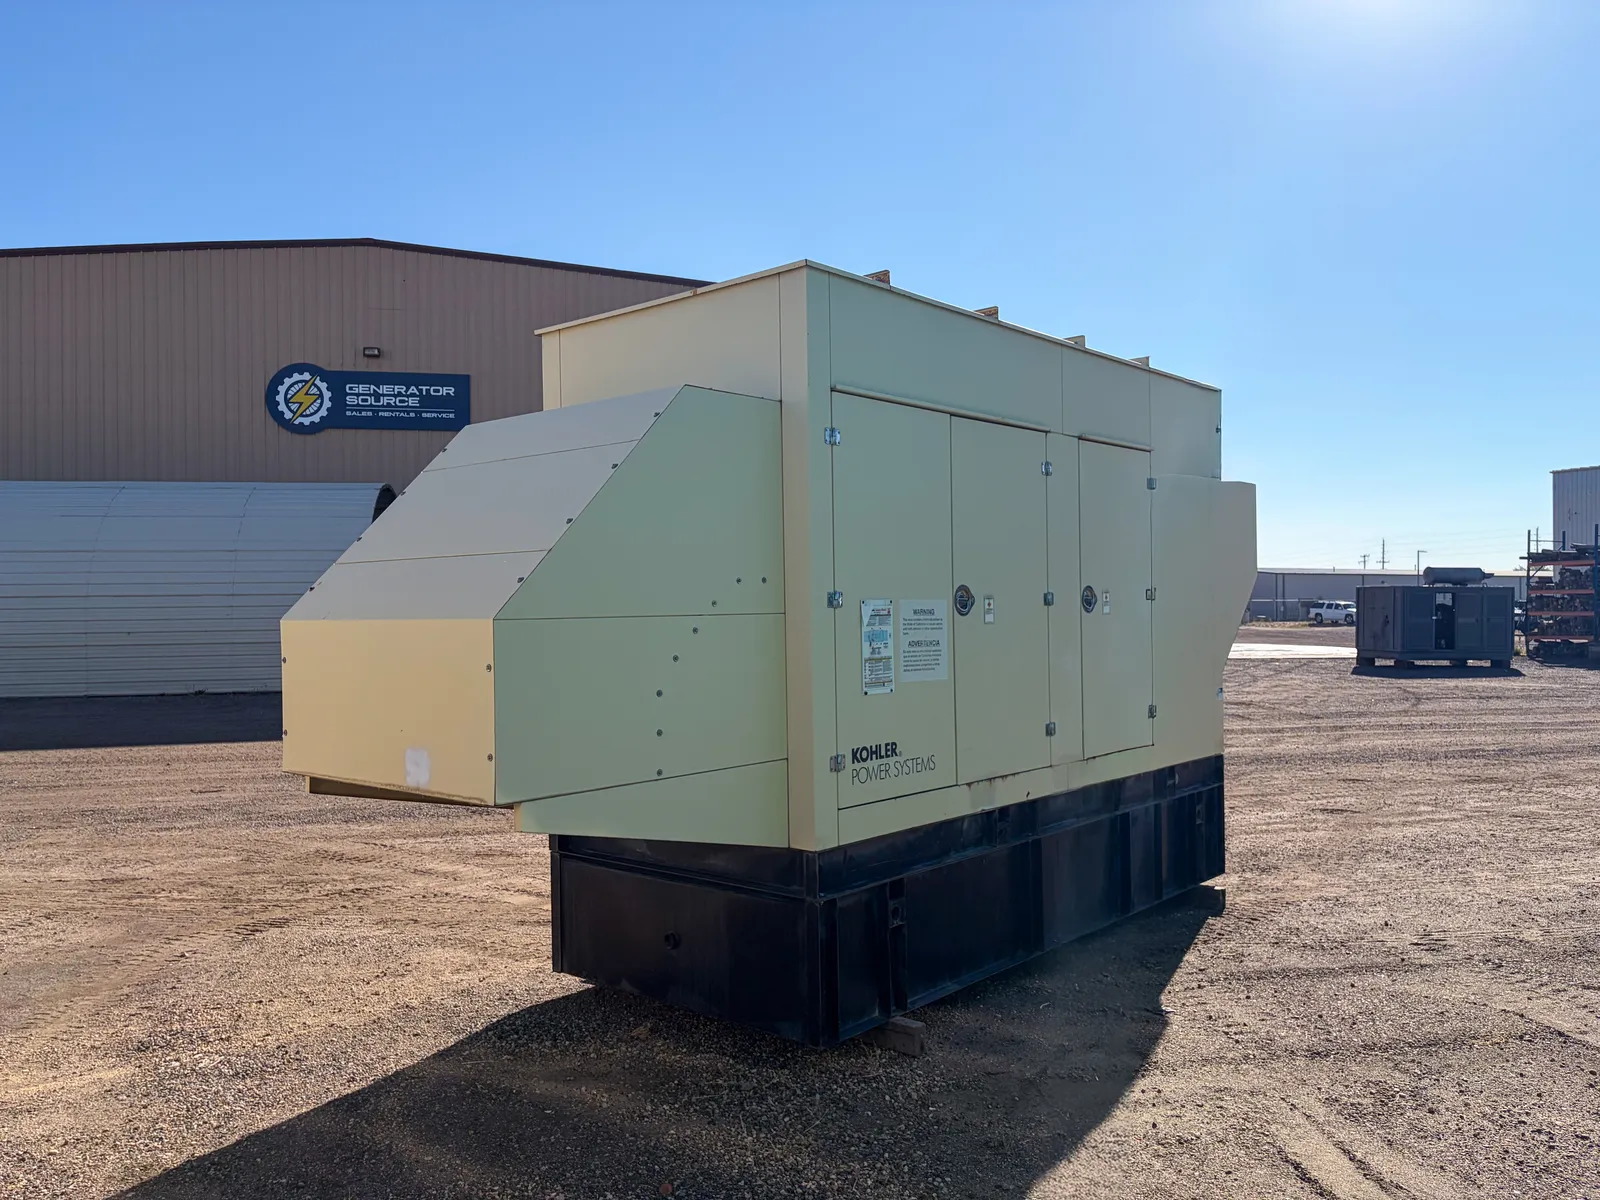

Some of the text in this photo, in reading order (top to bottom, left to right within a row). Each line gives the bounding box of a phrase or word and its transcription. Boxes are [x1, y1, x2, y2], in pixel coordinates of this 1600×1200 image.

[346, 384, 455, 396] GENERATOR
[346, 396, 420, 406] SOURCE
[851, 741, 899, 765] KOHLER
[851, 754, 936, 786] POWER SYSTEMS
